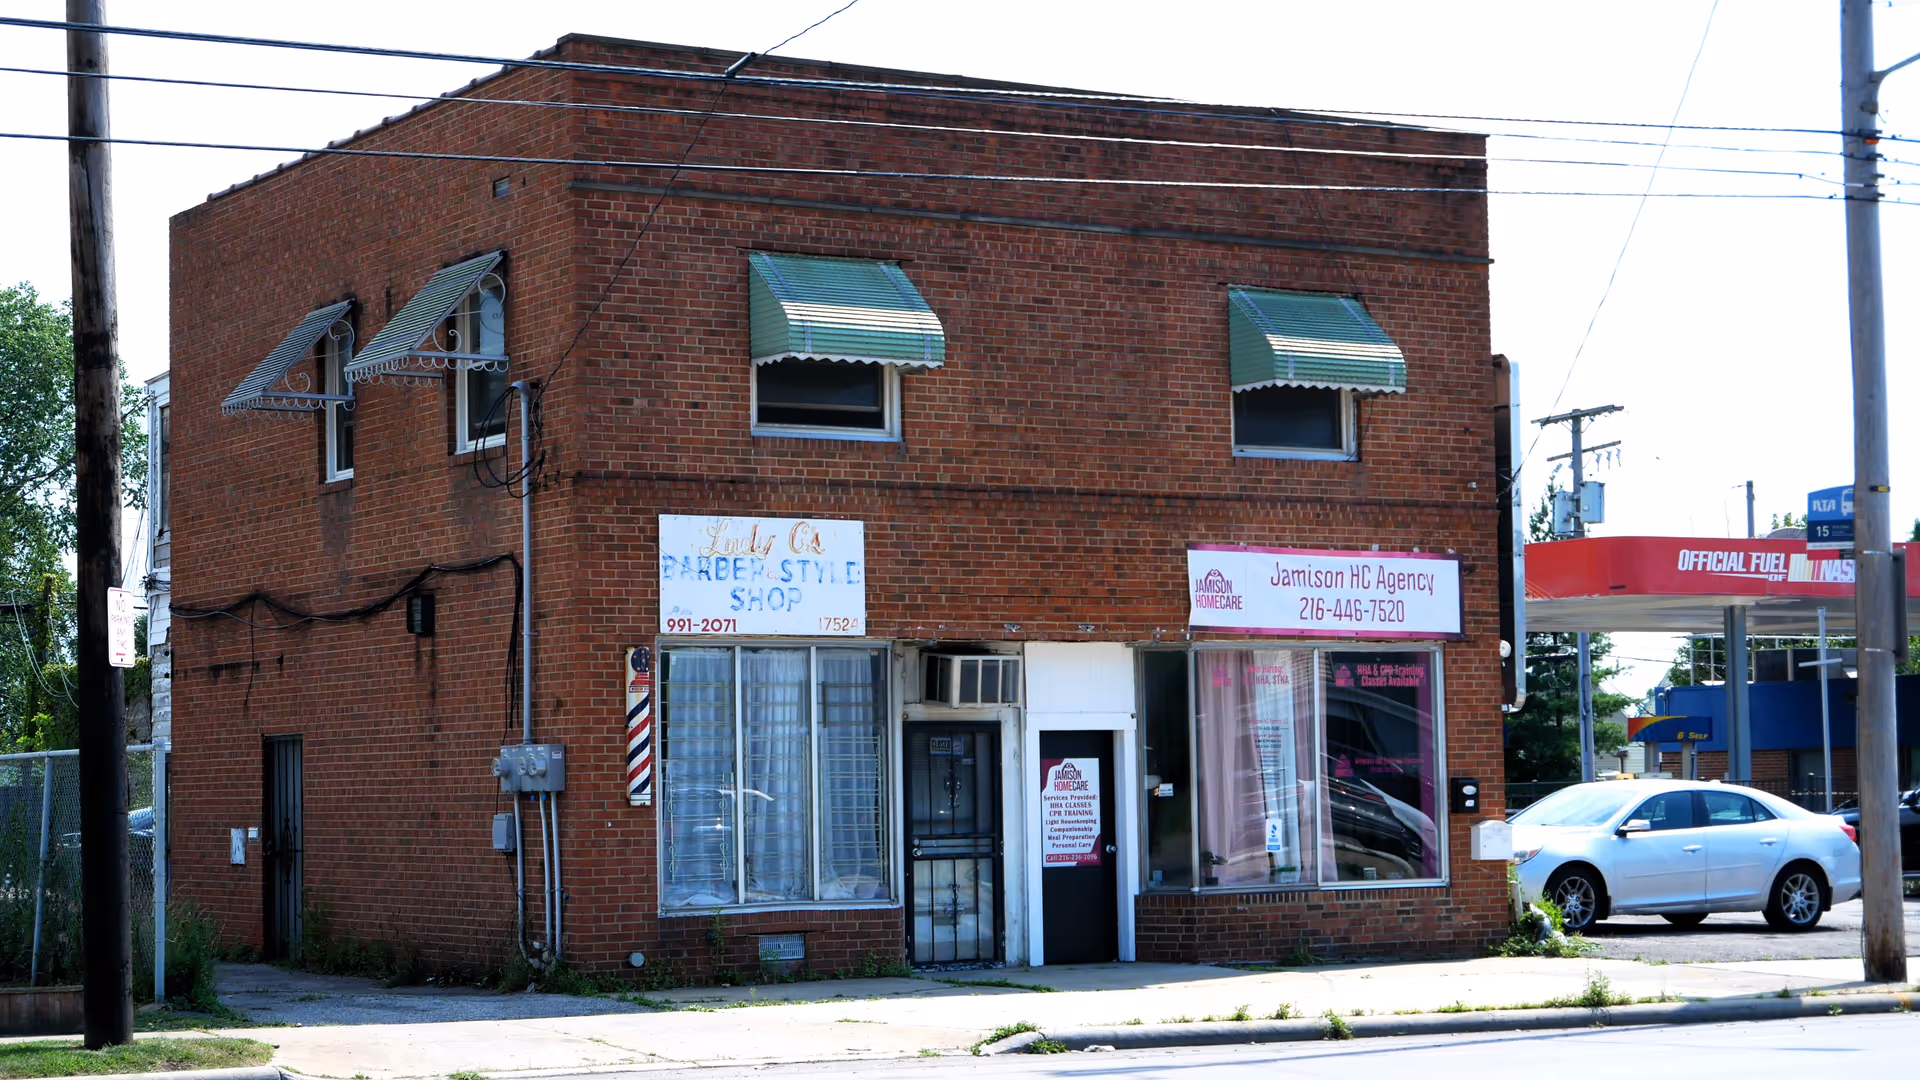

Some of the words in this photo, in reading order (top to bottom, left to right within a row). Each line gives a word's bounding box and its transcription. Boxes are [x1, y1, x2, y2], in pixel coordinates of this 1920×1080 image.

[1812, 499, 1836, 512] RTA
[1816, 525, 1830, 537] 15
[1678, 549, 1747, 572] OFFICIAL
[1748, 551, 1788, 573] FUEL
[662, 555, 764, 582] BARBER
[1820, 559, 1856, 581] NAS
[1270, 561, 1345, 589] Jamison
[1350, 564, 1371, 590] HC
[1376, 565, 1435, 596] Agency
[1768, 574, 1787, 582] OF
[1195, 578, 1233, 594] JAMISON
[116, 599, 125, 613] NO
[730, 587, 803, 612] SHOP
[1195, 594, 1243, 610] HOMECARE
[1300, 597, 1405, 623] 216-446-7520
[667, 618, 737, 632] 991-2071
[1054, 770, 1082, 780] JAMISON
[1054, 780, 1089, 791] HOMECARE
[1070, 793, 1098, 801] Provided:
[1065, 801, 1092, 809] CLASSES
